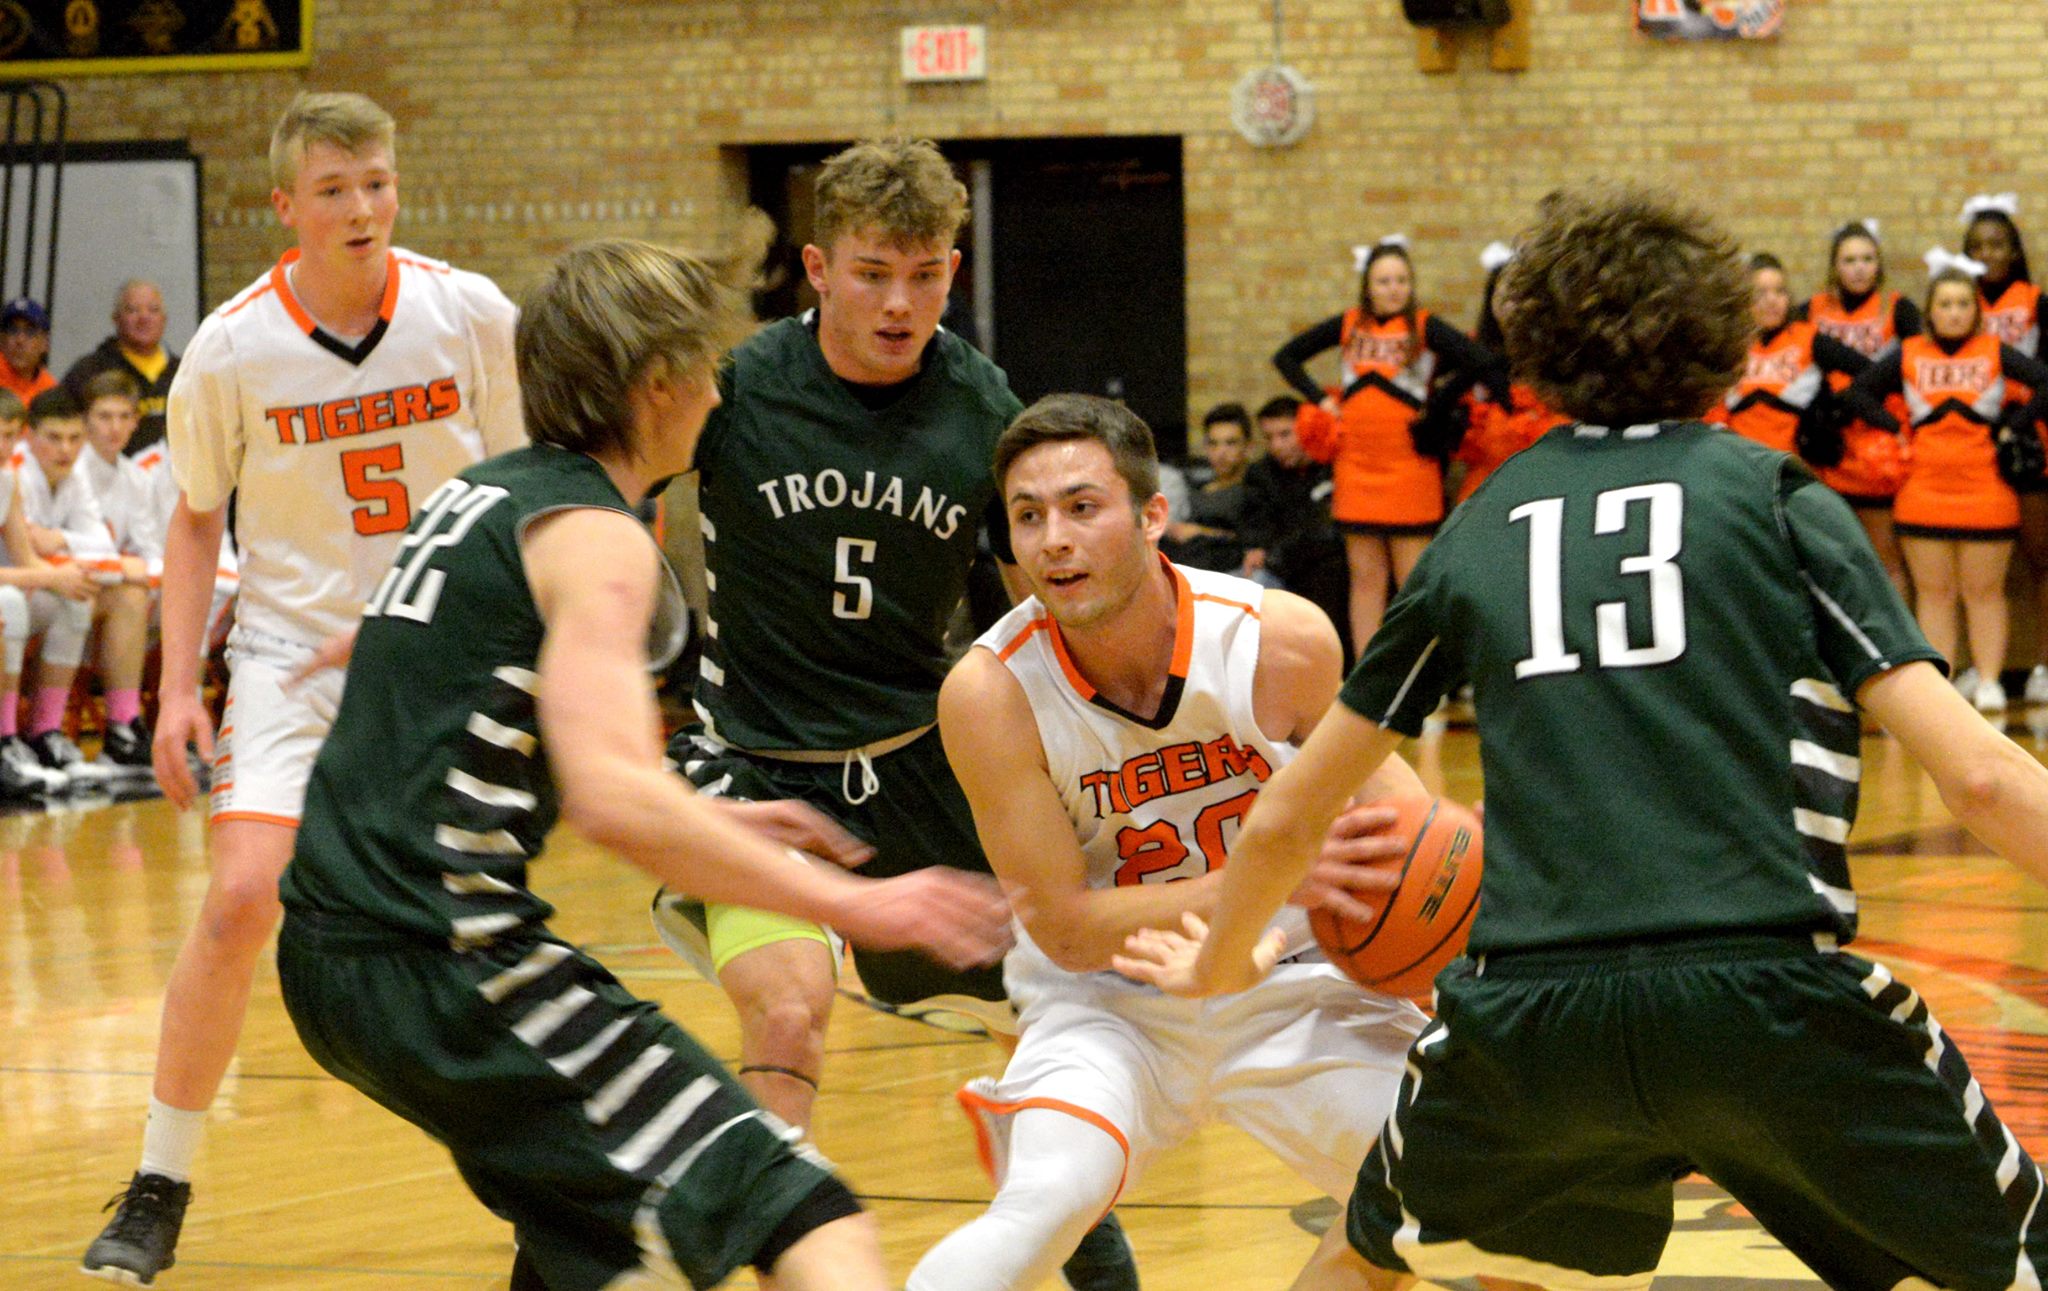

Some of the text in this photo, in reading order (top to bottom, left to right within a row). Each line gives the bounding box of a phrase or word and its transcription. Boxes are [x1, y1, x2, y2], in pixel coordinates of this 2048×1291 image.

[915, 30, 968, 74] EXIT
[265, 376, 461, 444] TIGERS
[340, 442, 411, 536] 5
[757, 468, 967, 540] TROJANS
[832, 536, 877, 620] 5
[1508, 482, 1687, 680] 13
[1079, 733, 1273, 819] TIGERS
